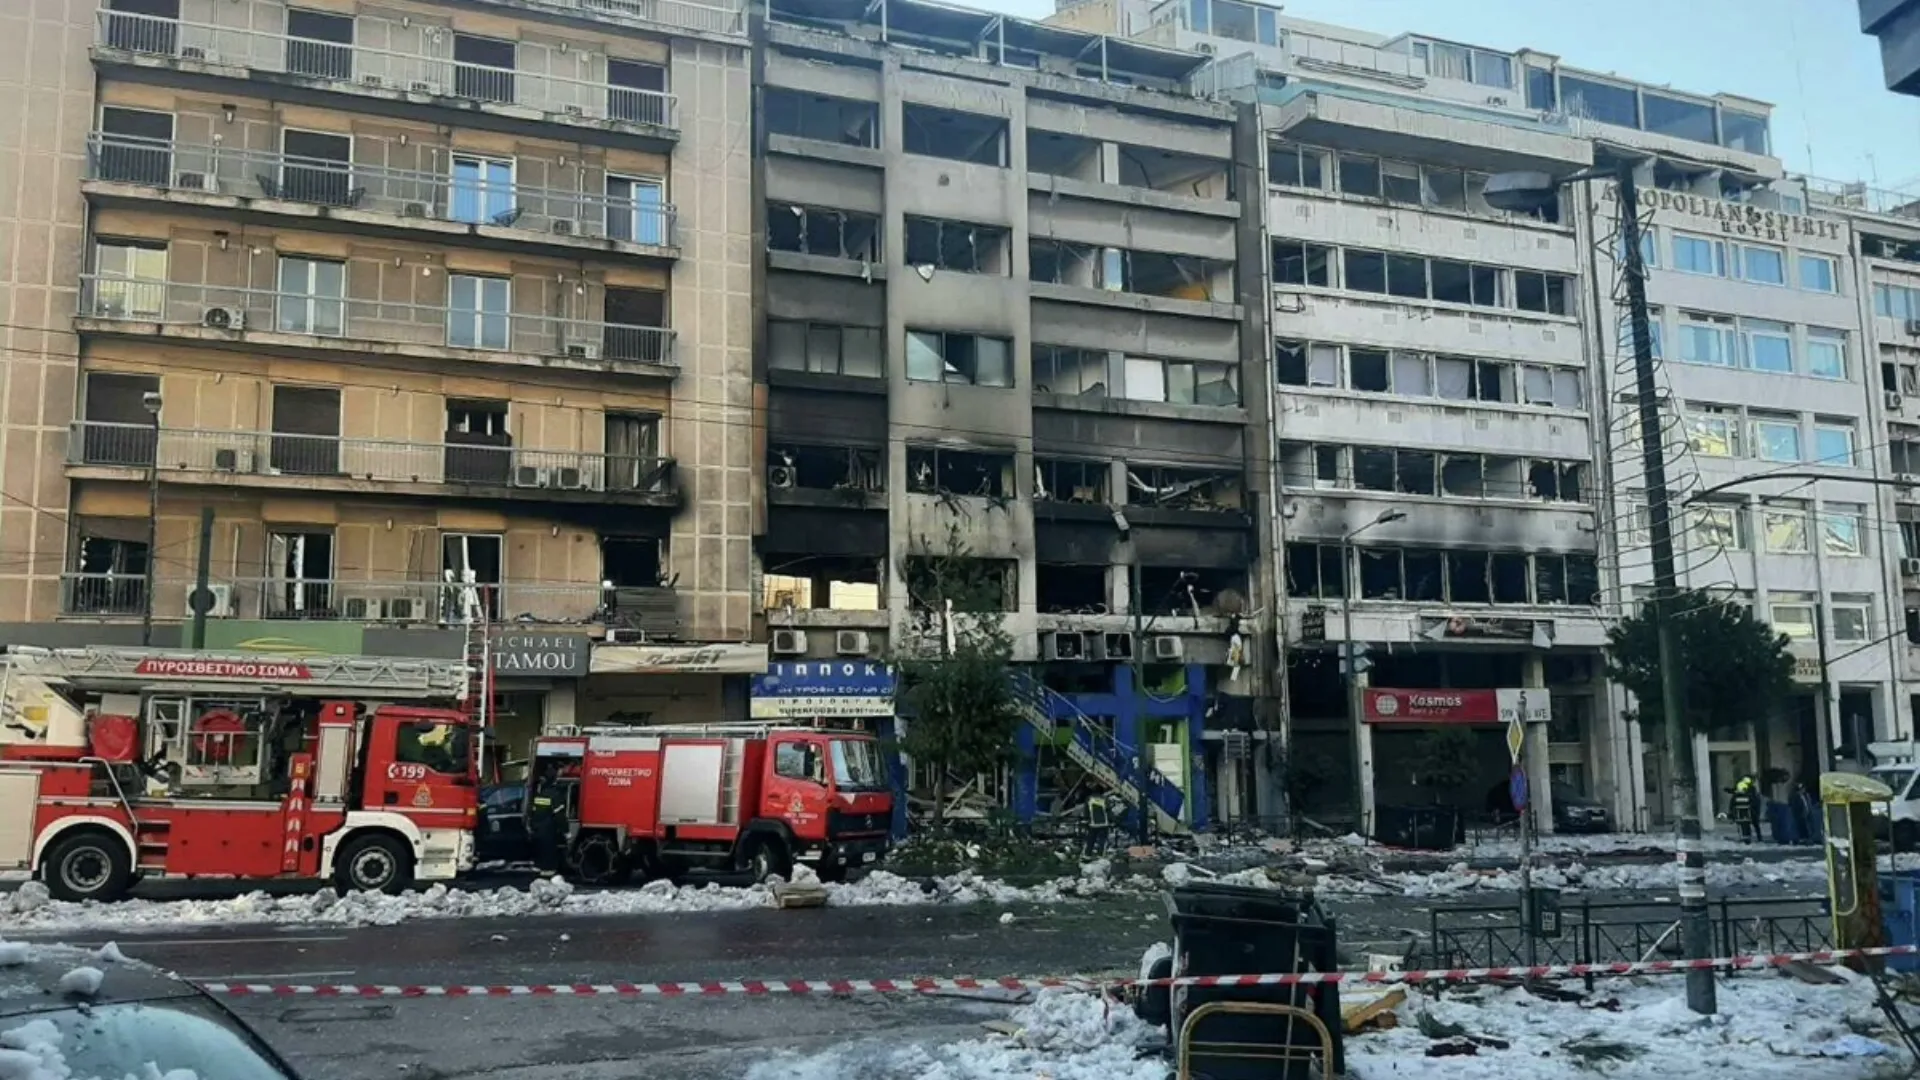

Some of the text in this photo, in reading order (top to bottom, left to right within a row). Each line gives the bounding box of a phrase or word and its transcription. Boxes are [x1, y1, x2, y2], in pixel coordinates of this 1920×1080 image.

[1601, 182, 1840, 239] AOPOLIAN SPIRIT
[484, 636, 577, 649] ICHAEL
[483, 651, 577, 670] TAMOU
[146, 660, 299, 677] ΠΥΡΟΣΒΕΣΤΙΚΟ ΣΩΜΑ
[1408, 694, 1463, 708] Kosmos
[401, 765, 426, 779] 199
